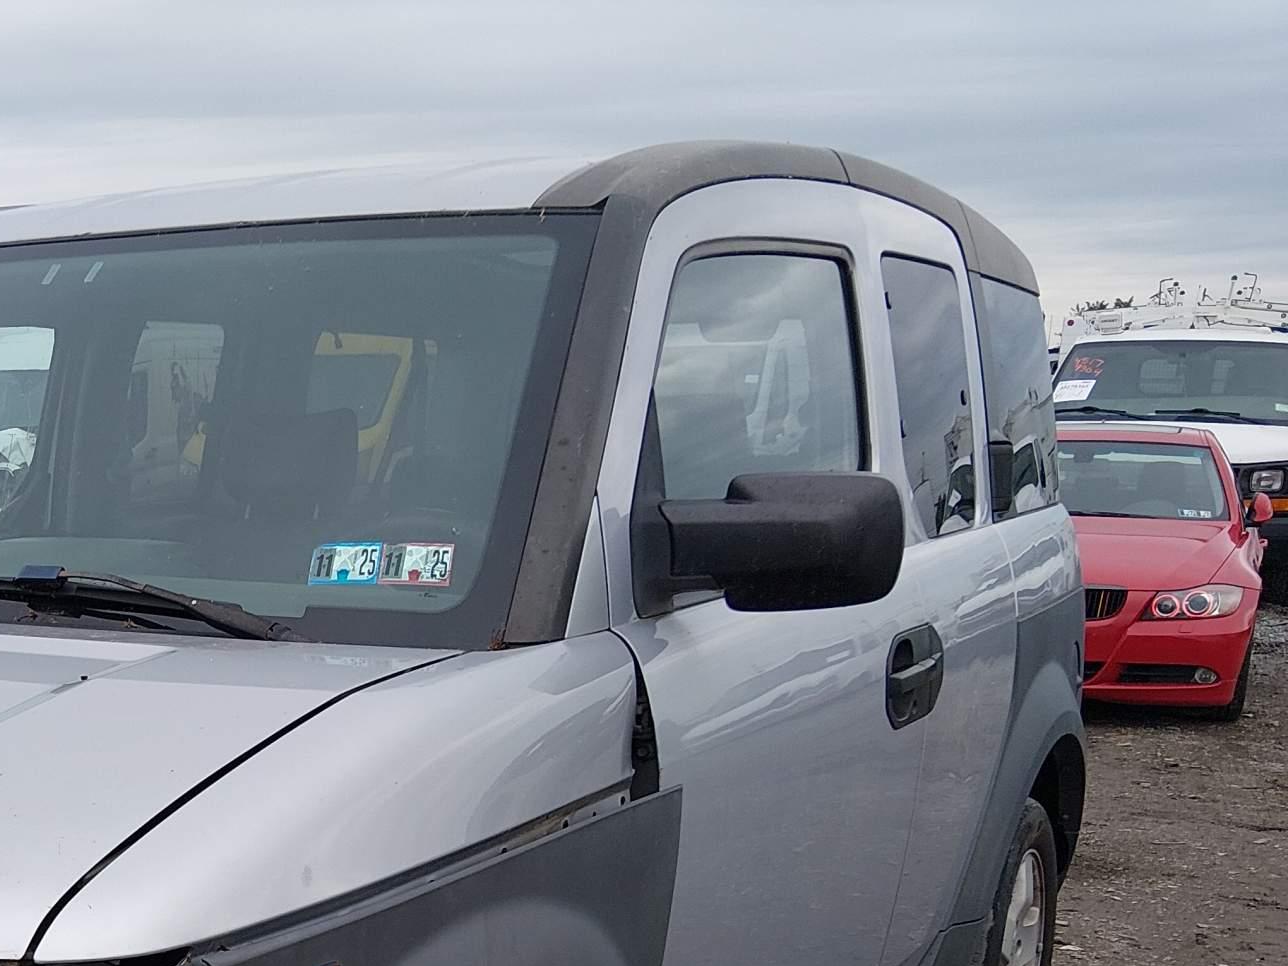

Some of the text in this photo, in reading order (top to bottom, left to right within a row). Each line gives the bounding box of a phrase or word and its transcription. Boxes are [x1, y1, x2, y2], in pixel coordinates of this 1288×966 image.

[316, 549, 377, 578] 11 25
[384, 550, 449, 580] 11 25
